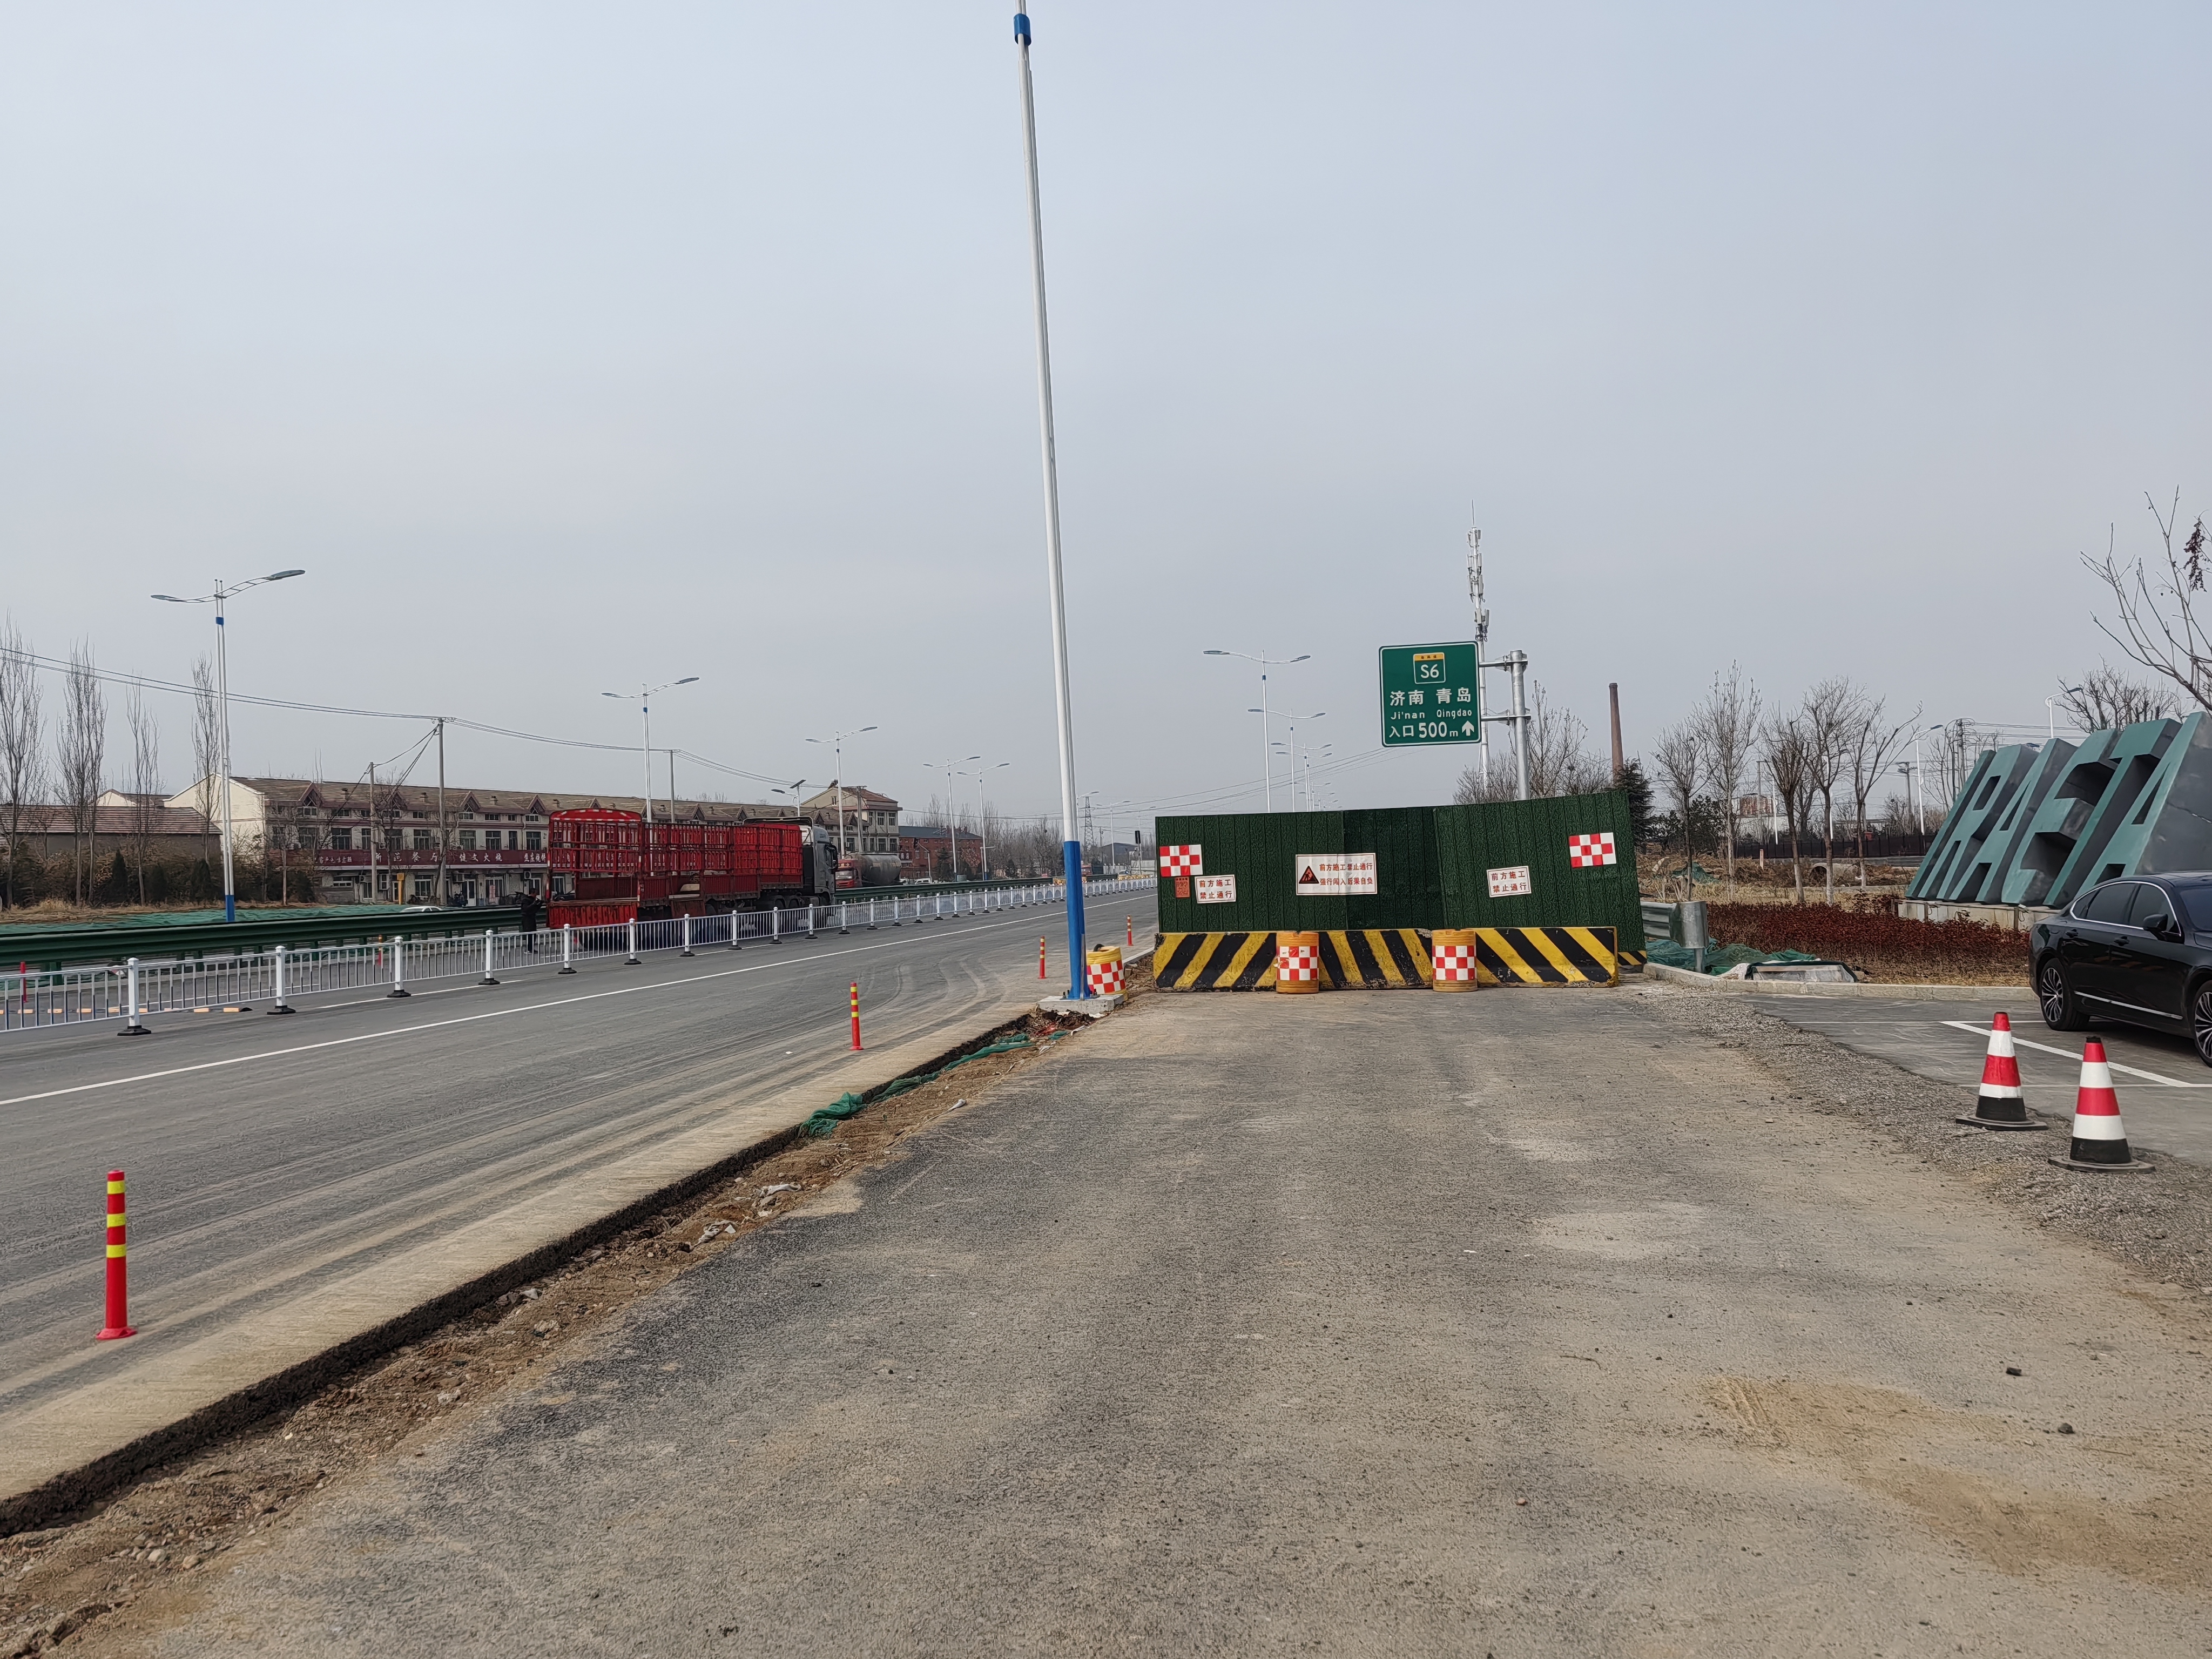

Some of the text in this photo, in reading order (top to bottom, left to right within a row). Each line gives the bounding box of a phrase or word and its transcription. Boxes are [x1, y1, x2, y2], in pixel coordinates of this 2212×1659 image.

[1421, 664, 1439, 678] S6
[1390, 687, 1471, 706] 济南 青岛
[1391, 709, 1472, 720] Ji'nan Qingdao
[1319, 862, 1373, 871] 前方施工禁止通行
[1491, 871, 1526, 881] 前方施工
[1198, 879, 1232, 888] 前方施工
[1320, 877, 1373, 886] 强行闯入后果自负
[1493, 882, 1527, 893] 禁止通行
[1199, 890, 1232, 900] 禁止通行
